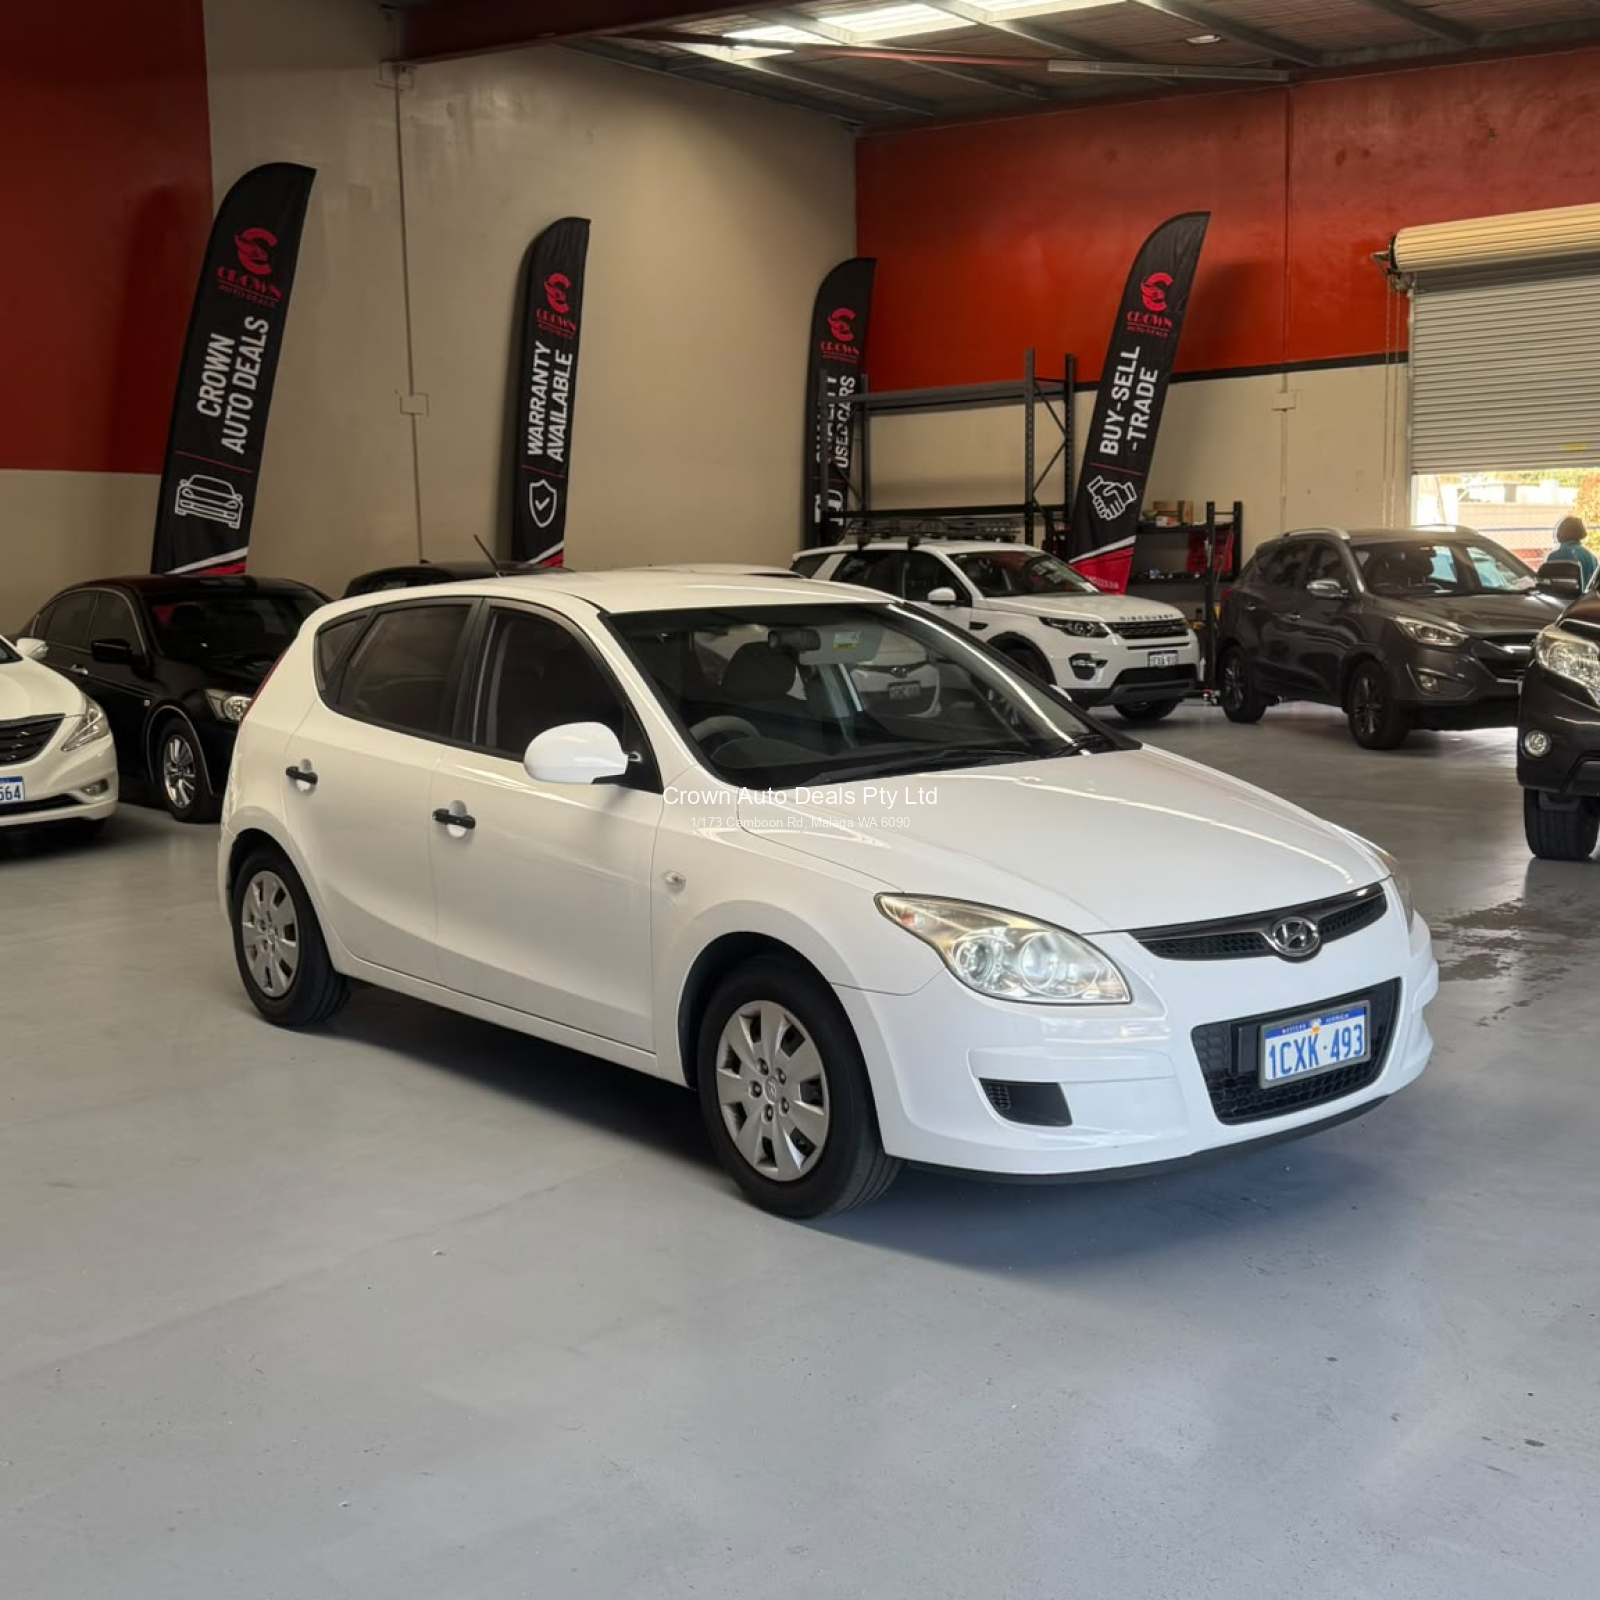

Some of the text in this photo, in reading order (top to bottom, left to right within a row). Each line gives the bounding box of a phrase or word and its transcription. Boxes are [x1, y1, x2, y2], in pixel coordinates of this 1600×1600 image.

[197, 333, 236, 418] CROWN
[221, 315, 270, 455] AUTO DEALS
[527, 341, 552, 457] WARRANTY
[547, 352, 573, 463] AVAILABLE
[1099, 345, 1141, 456] BUY-SELL
